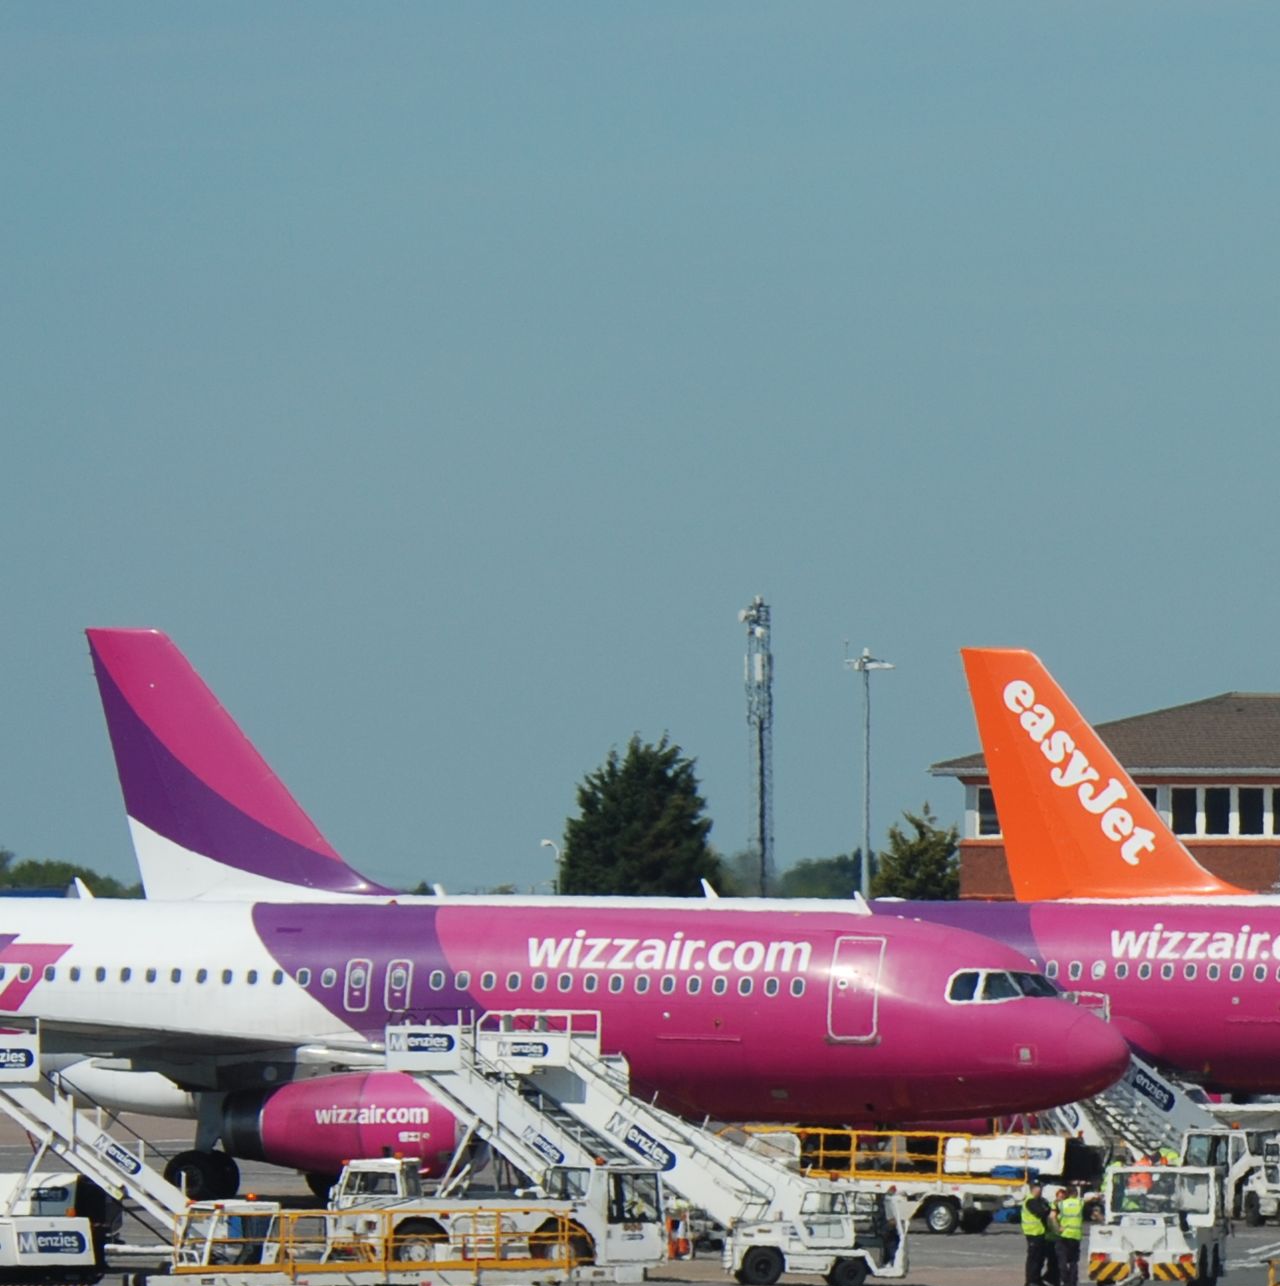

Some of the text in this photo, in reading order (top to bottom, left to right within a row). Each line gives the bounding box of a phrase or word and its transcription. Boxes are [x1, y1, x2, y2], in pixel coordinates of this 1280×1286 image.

[1003, 679, 1156, 866] easyJet
[527, 928, 813, 973] wizzair.com
[389, 1032, 449, 1052] Menzies
[498, 1042, 544, 1058] Menzies
[0, 1049, 26, 1063] zies
[1127, 1063, 1170, 1104] enzies
[315, 1104, 430, 1125] wizzair.com
[604, 1111, 670, 1165] Menzies
[18, 1231, 79, 1254] Menzies
